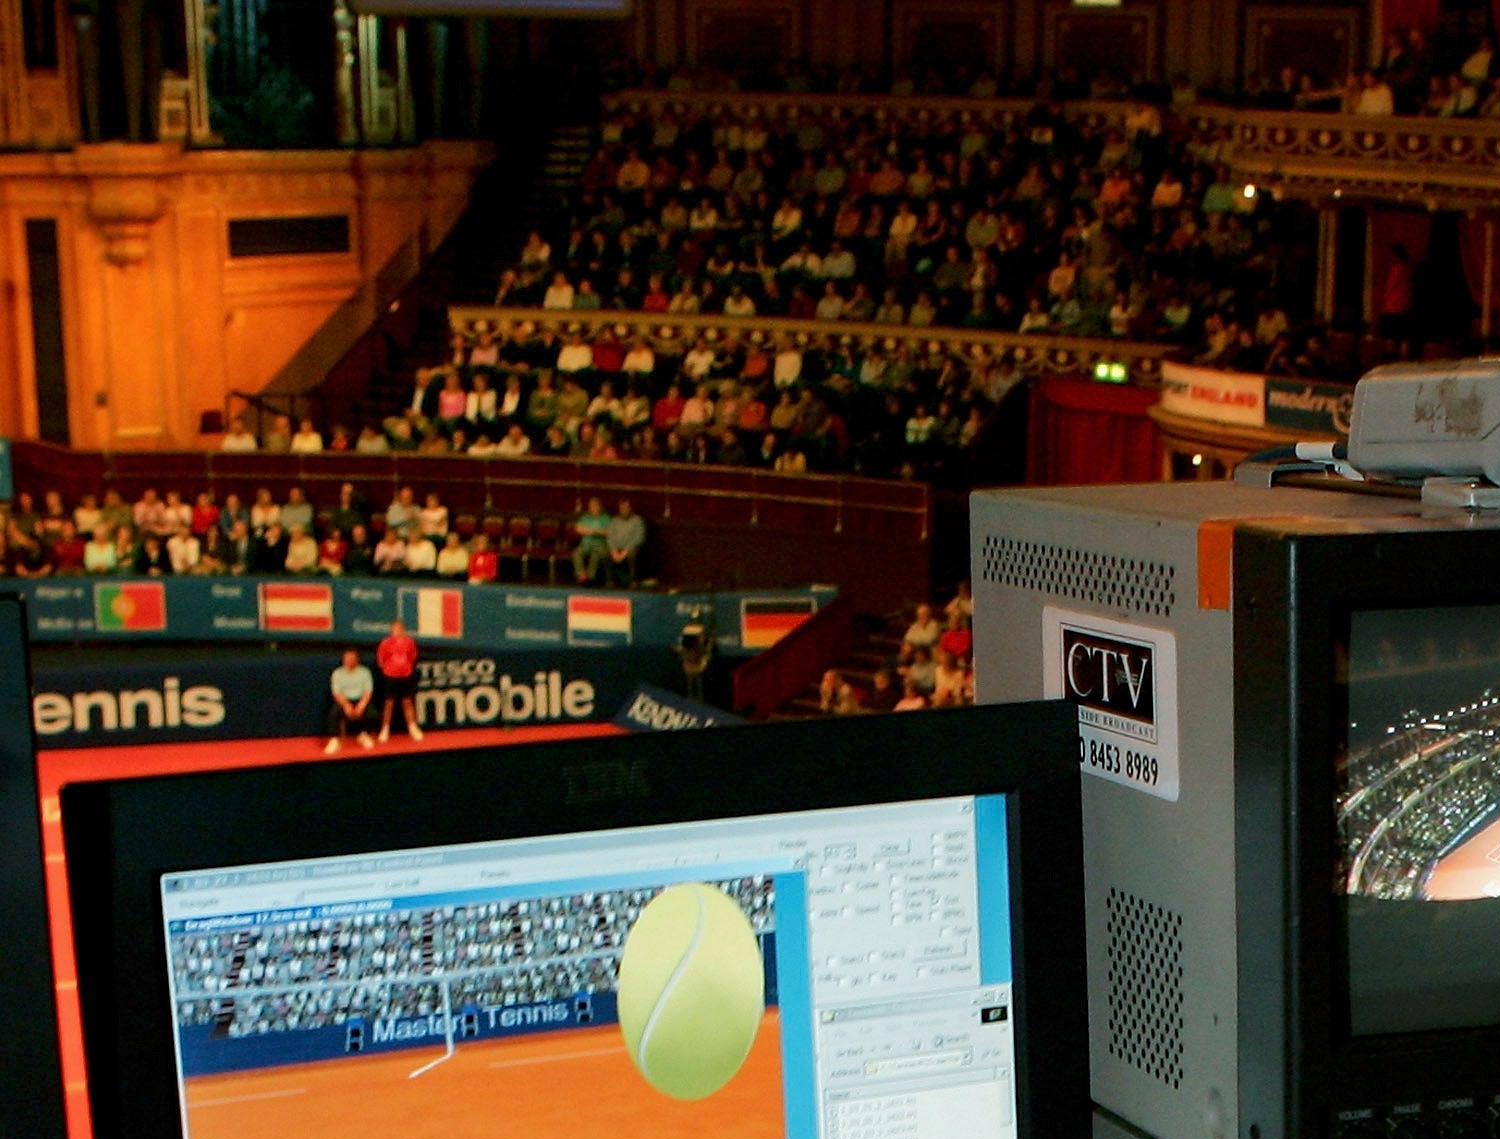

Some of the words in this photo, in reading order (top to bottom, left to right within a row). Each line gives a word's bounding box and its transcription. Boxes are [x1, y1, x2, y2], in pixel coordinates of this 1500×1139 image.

[415, 657, 496, 679] TESCO
[1068, 642, 1149, 709] CTV
[33, 677, 226, 735] ennis
[415, 671, 595, 725] mobile
[1089, 740, 1120, 774] 8453
[1126, 750, 1158, 786] 8989
[482, 1001, 569, 1029] Tennis
